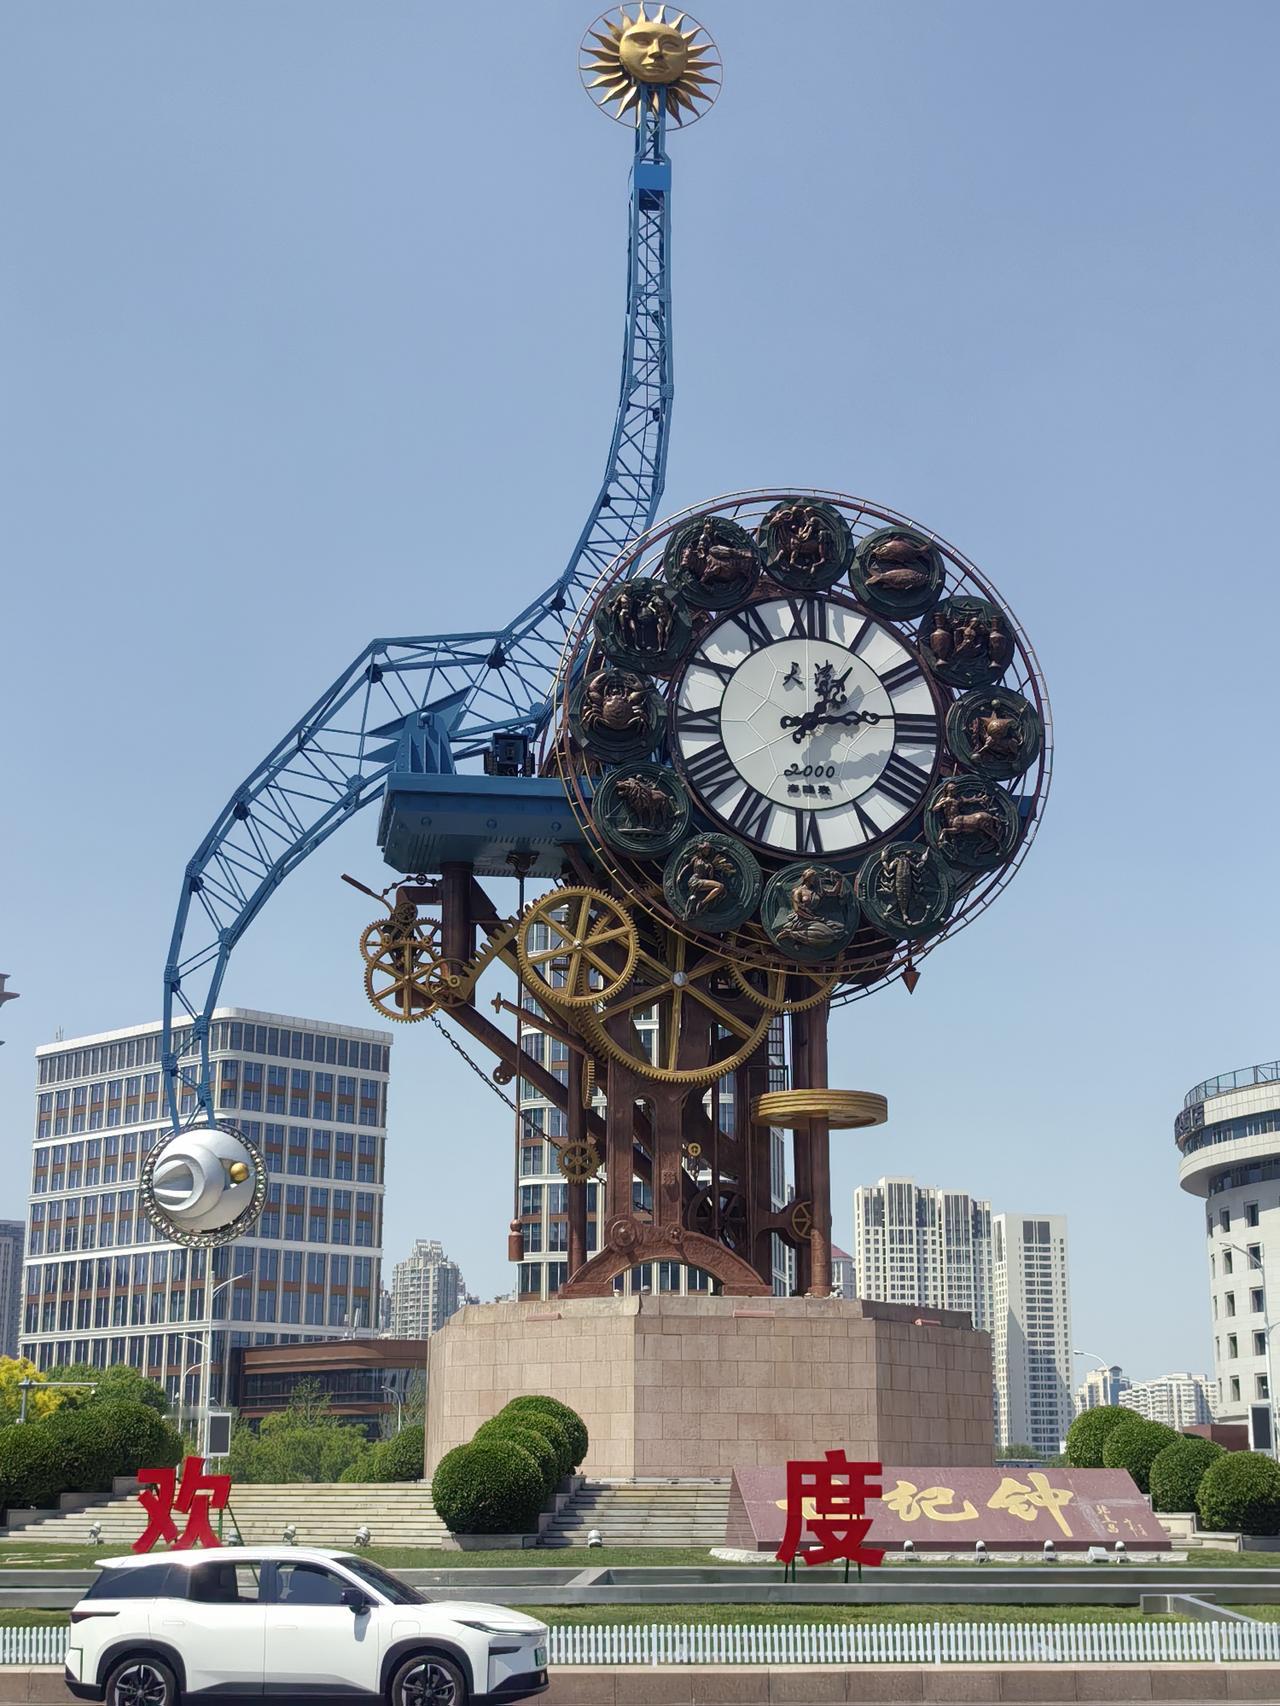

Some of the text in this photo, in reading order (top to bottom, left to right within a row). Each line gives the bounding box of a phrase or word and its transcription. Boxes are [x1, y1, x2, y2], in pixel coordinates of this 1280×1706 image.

[784, 763, 835, 778] 2000
[132, 1449, 886, 1566] 欢 度
